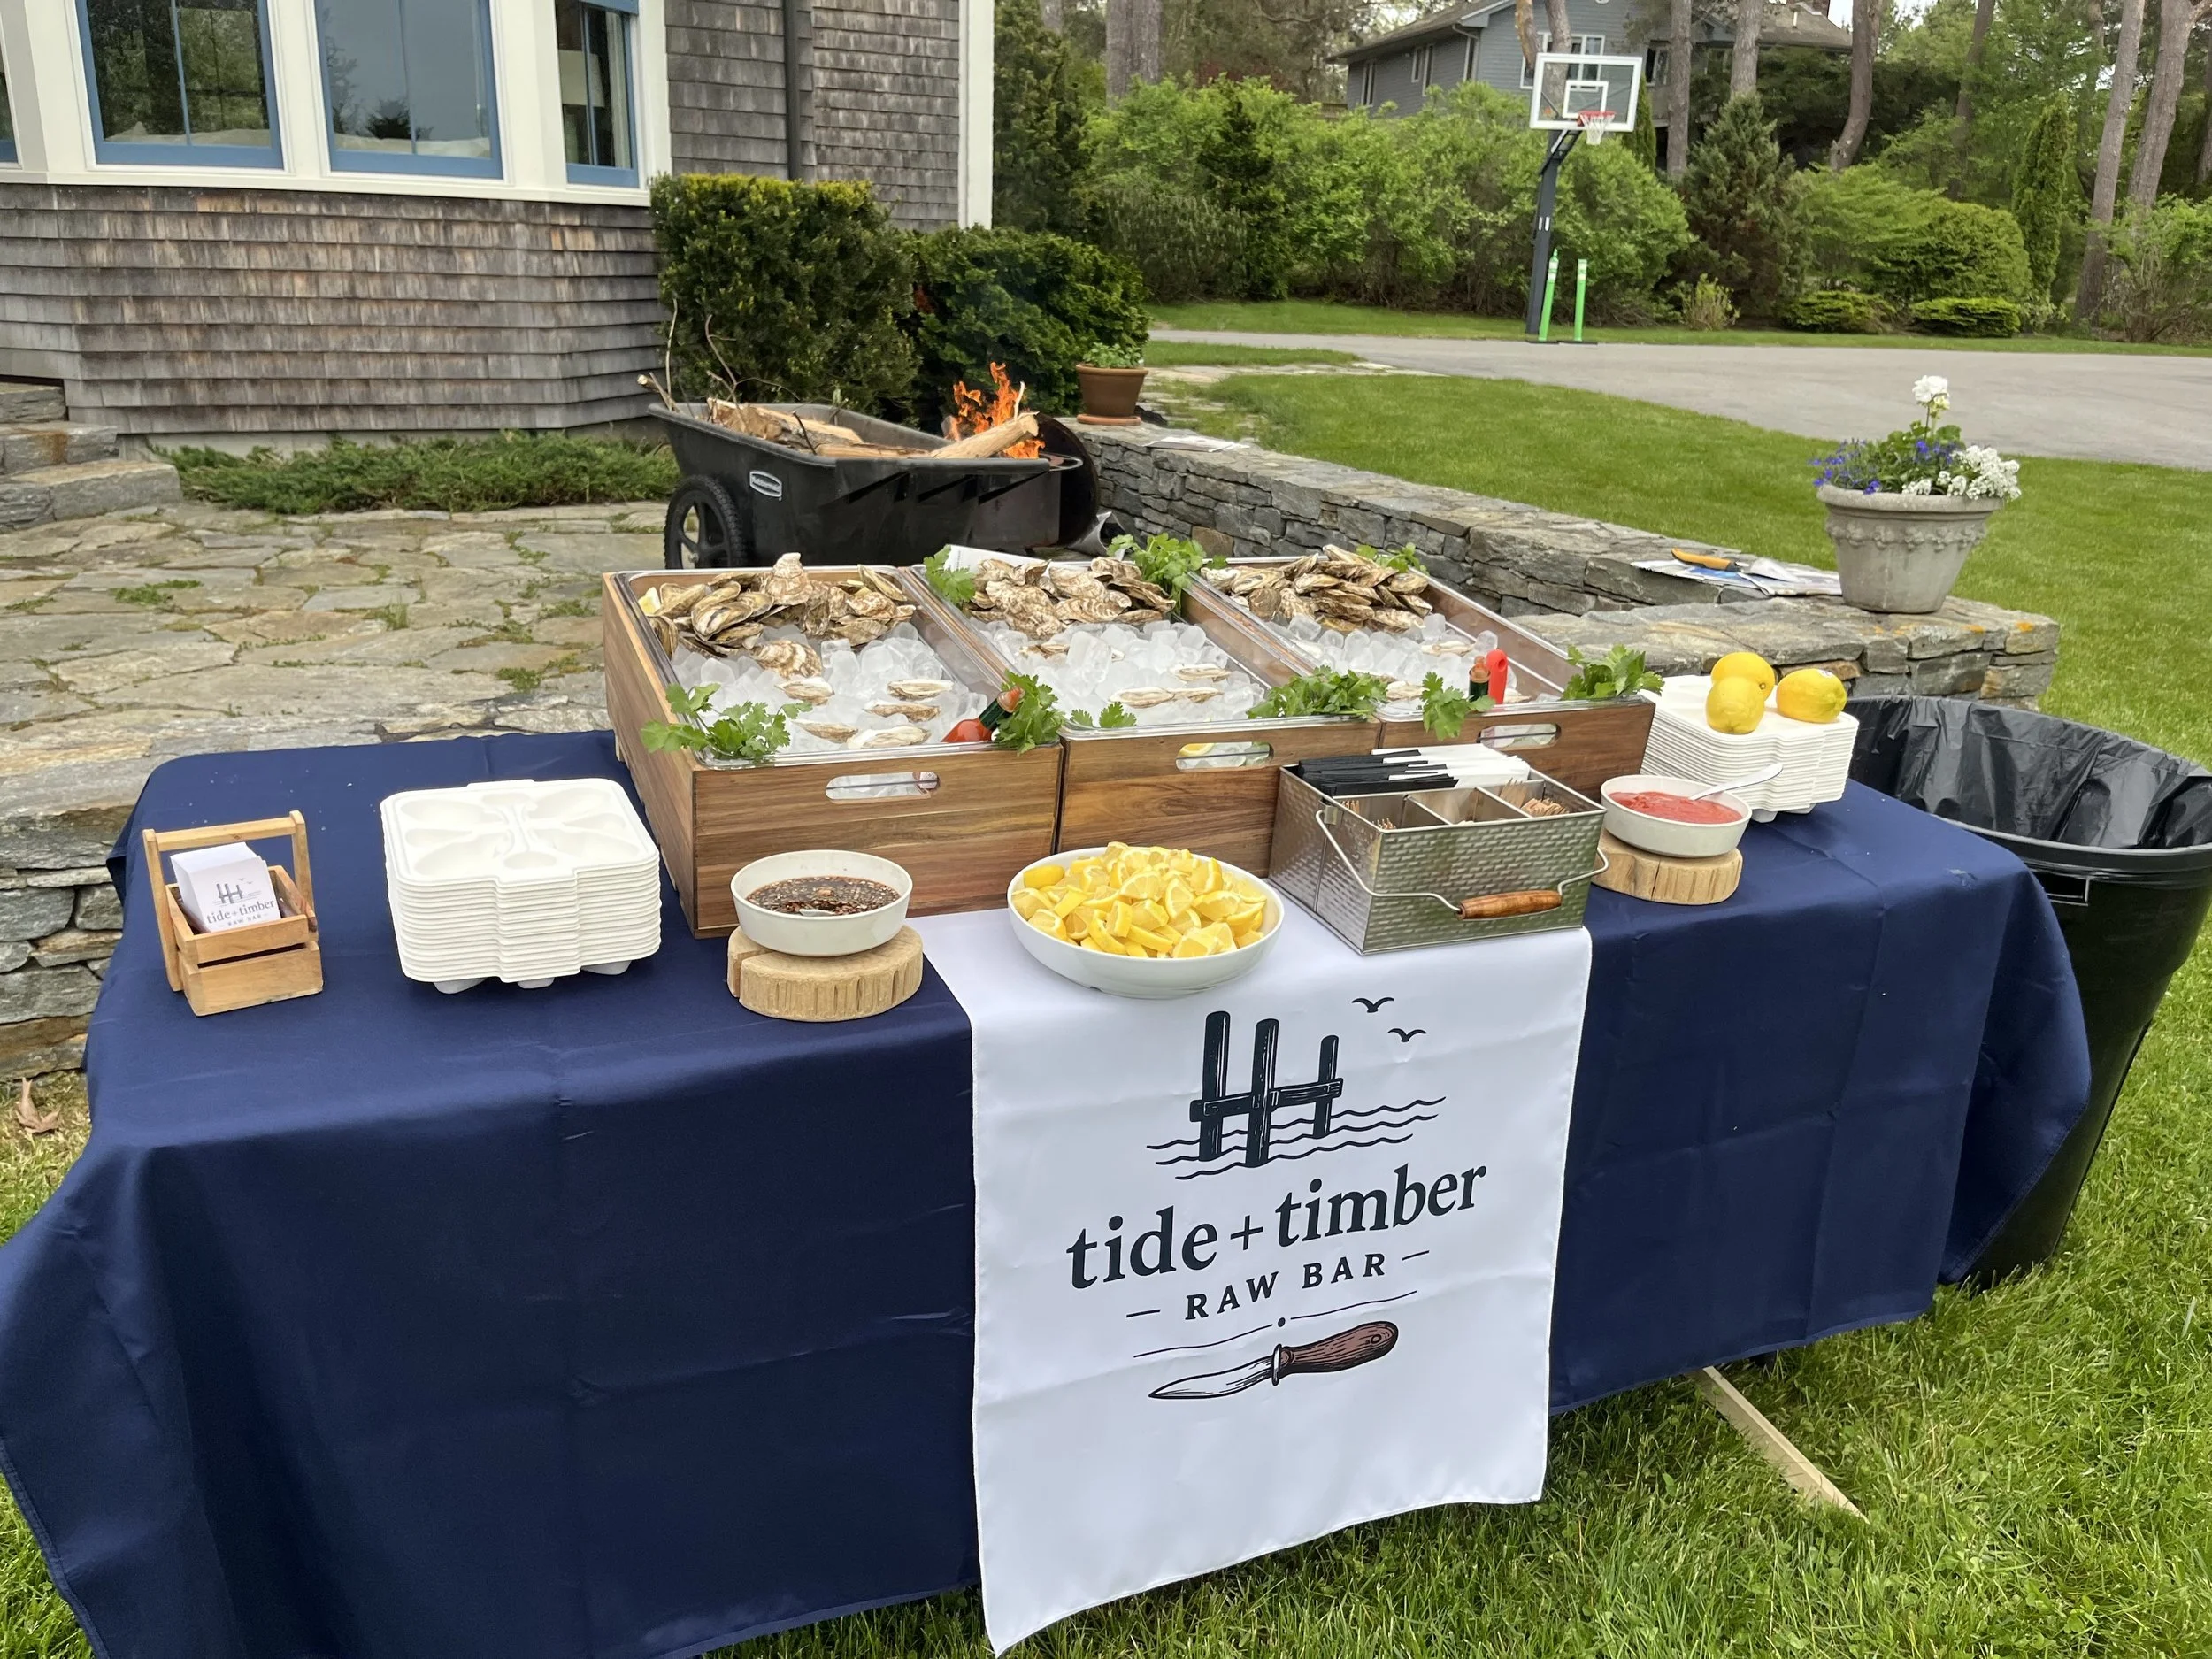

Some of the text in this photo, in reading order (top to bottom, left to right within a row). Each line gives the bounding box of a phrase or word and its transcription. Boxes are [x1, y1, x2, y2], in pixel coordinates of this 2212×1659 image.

[206, 910, 231, 924] tide
[239, 901, 274, 915] timber
[1065, 1163, 1487, 1289] tide + timber
[1184, 1253, 1386, 1321] RAW BAR
